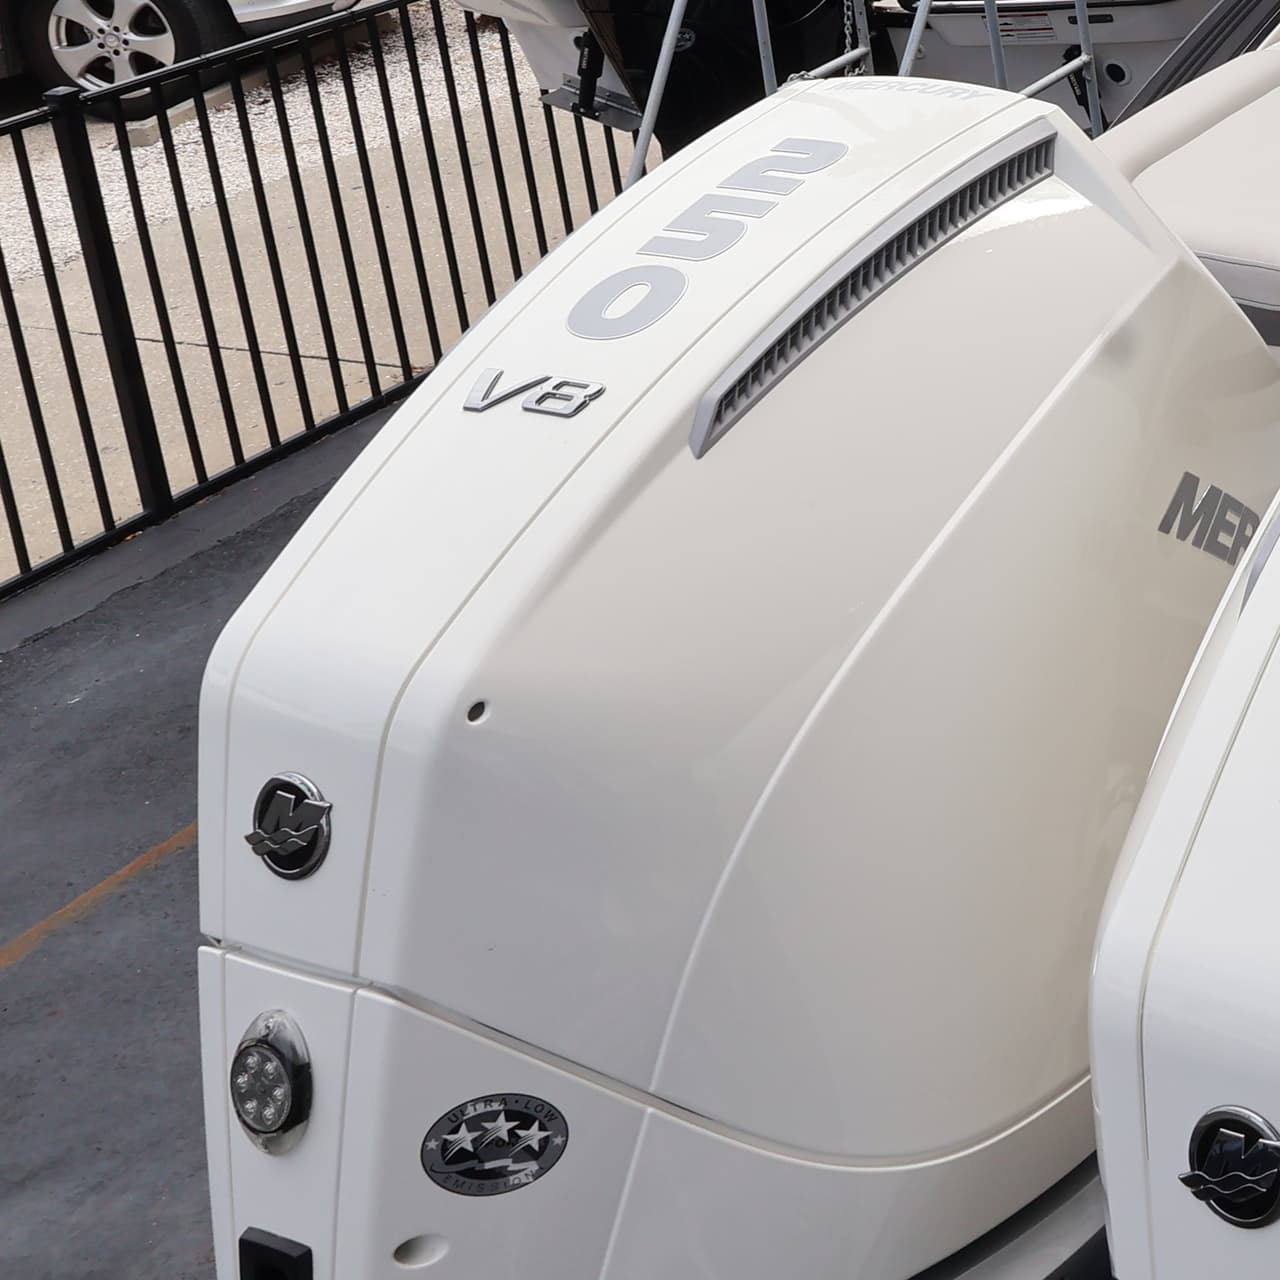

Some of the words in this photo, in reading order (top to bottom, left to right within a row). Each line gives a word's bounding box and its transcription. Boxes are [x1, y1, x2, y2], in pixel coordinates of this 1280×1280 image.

[824, 80, 997, 100] MERCURY
[565, 136, 849, 340] 250
[463, 367, 606, 418] V8
[447, 1096, 509, 1124] ULTRA
[523, 1098, 559, 1124] LOW
[441, 1169, 537, 1194] EMISSION
